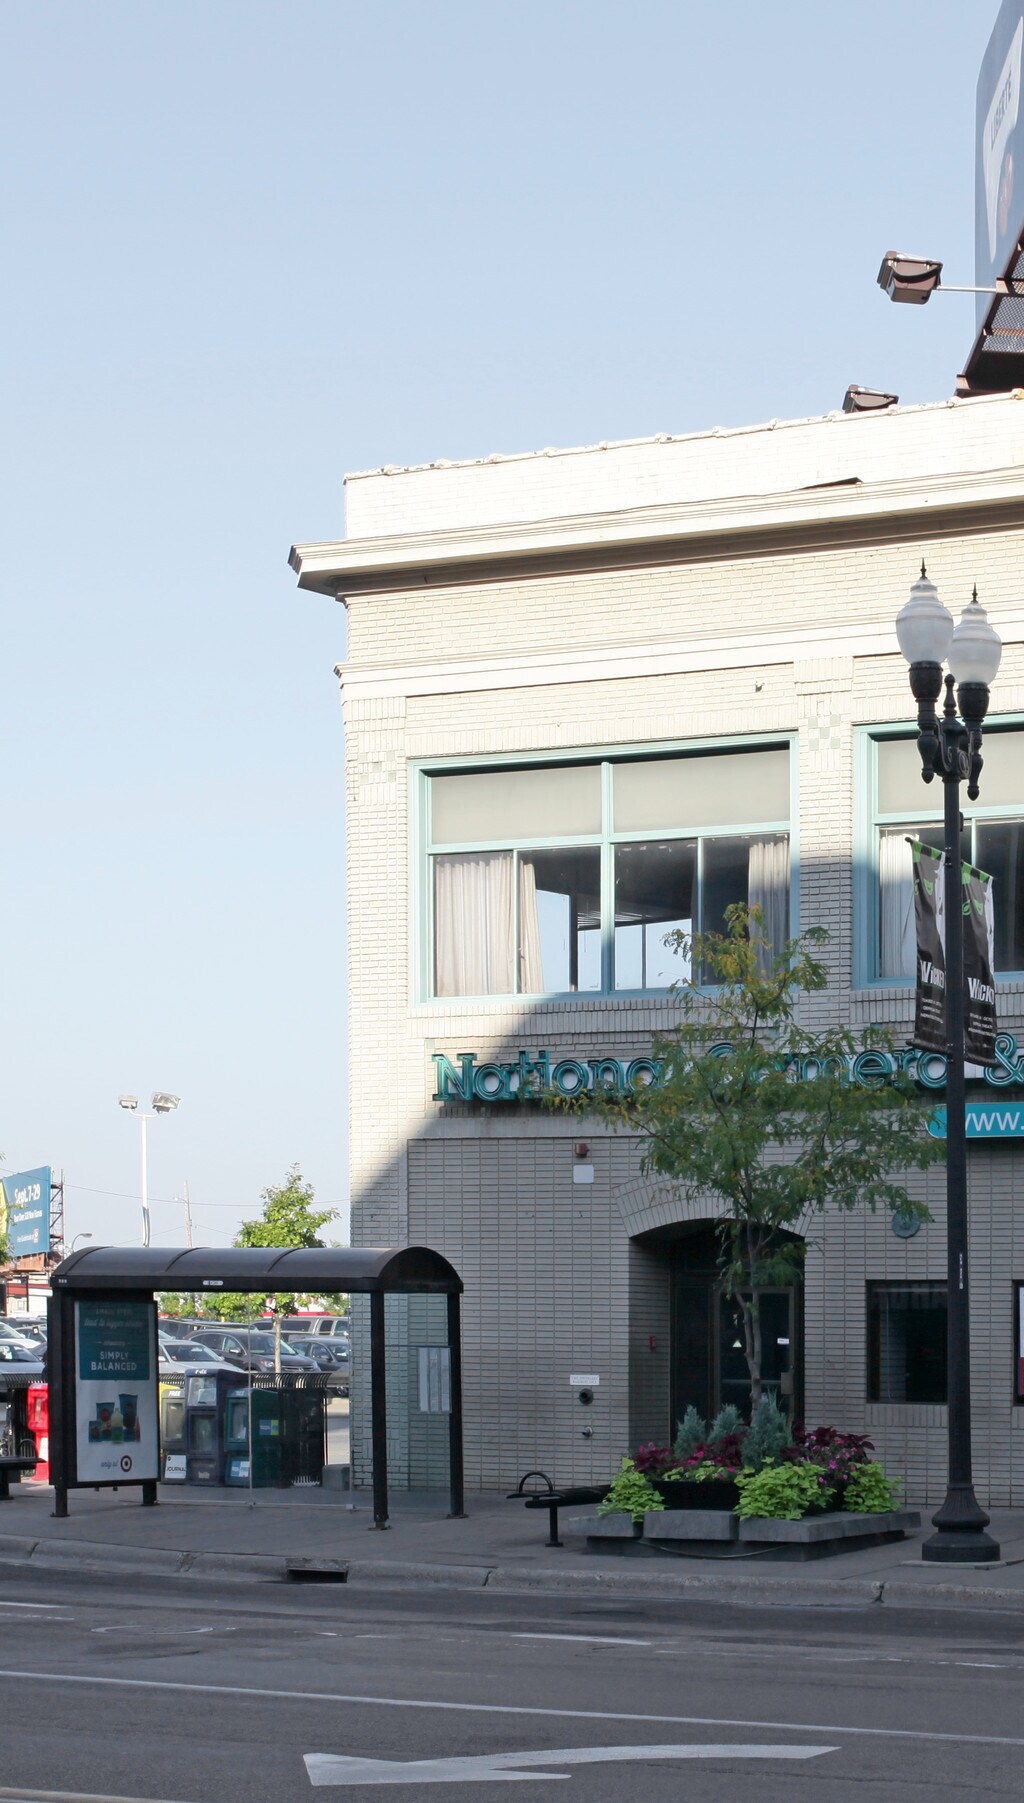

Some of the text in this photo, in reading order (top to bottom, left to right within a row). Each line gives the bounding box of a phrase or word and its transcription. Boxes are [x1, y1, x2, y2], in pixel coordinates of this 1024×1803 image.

[432, 1051, 682, 1101] Nationa
[100, 1351, 129, 1360] SIMPLY
[90, 1361, 137, 1371] BALANCED
